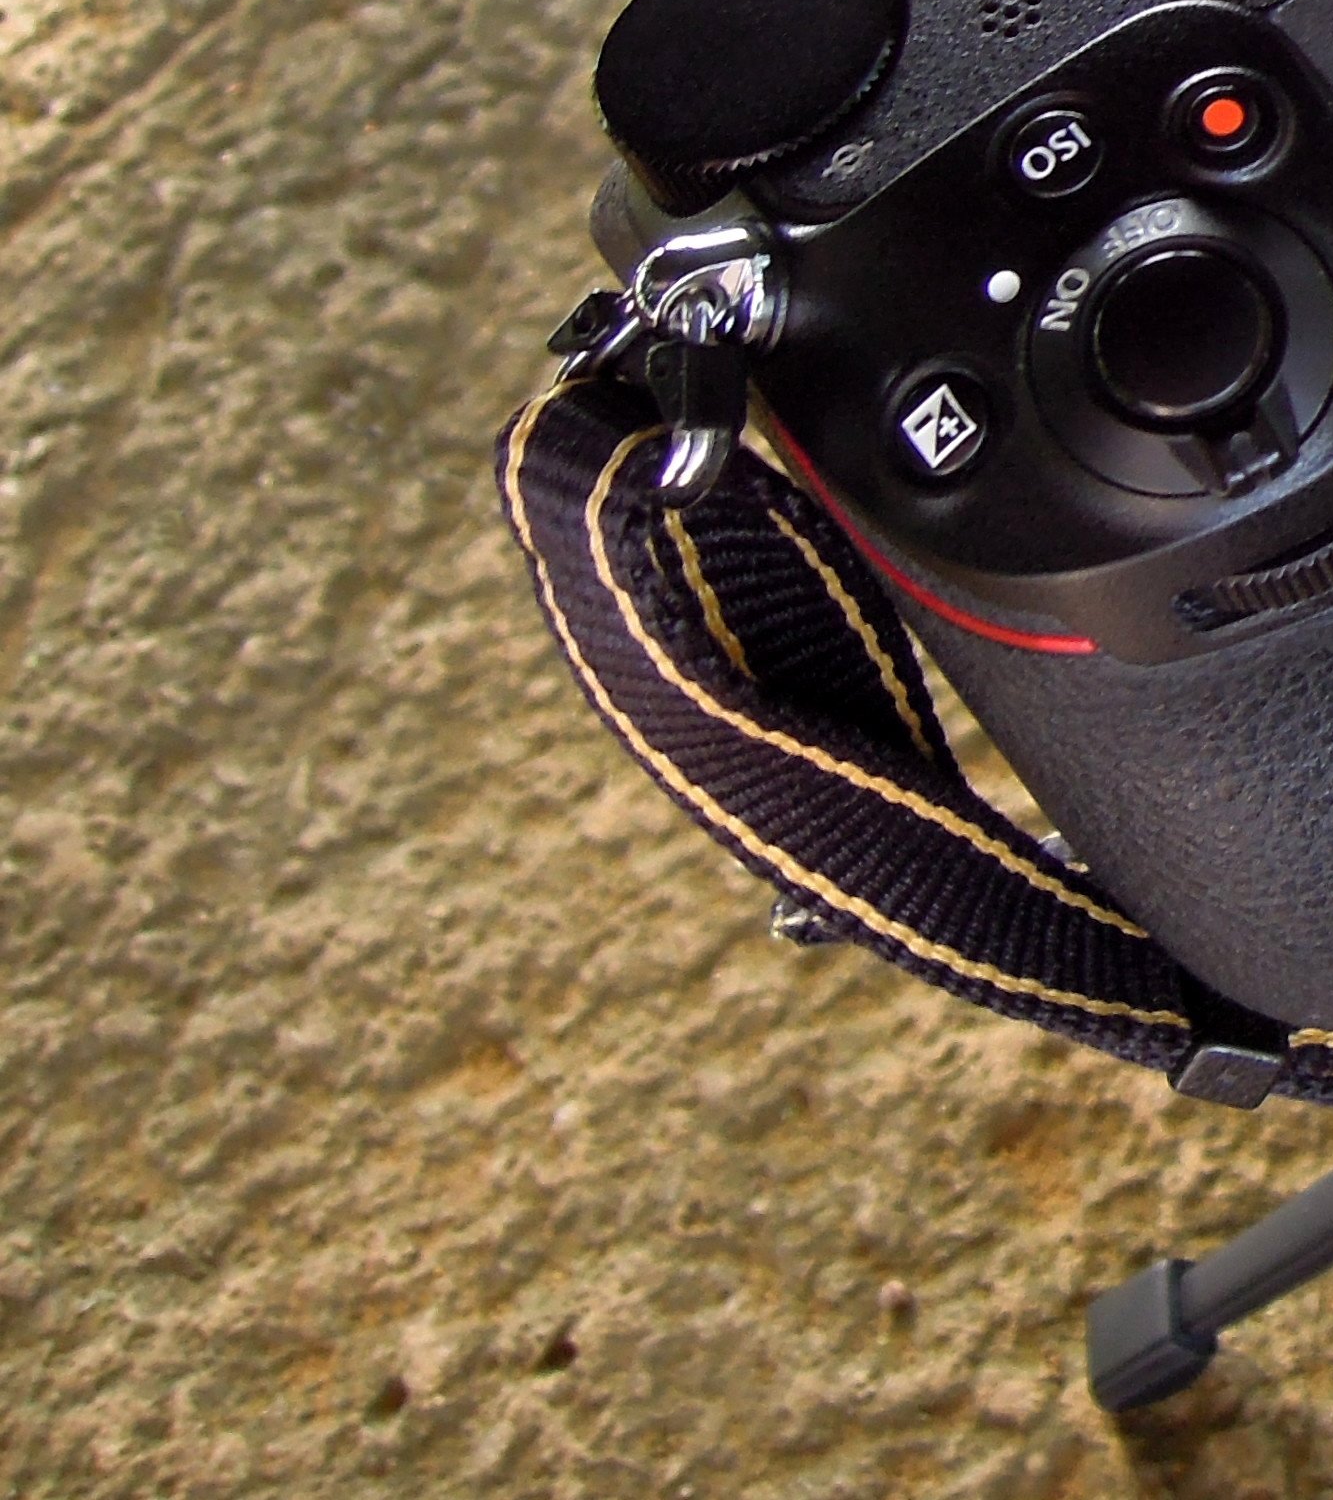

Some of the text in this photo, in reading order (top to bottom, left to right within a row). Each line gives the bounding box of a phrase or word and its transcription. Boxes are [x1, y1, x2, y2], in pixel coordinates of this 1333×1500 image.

[1020, 123, 1092, 181] ISO
[1101, 203, 1181, 258] OFF
[1040, 267, 1091, 332] ON
